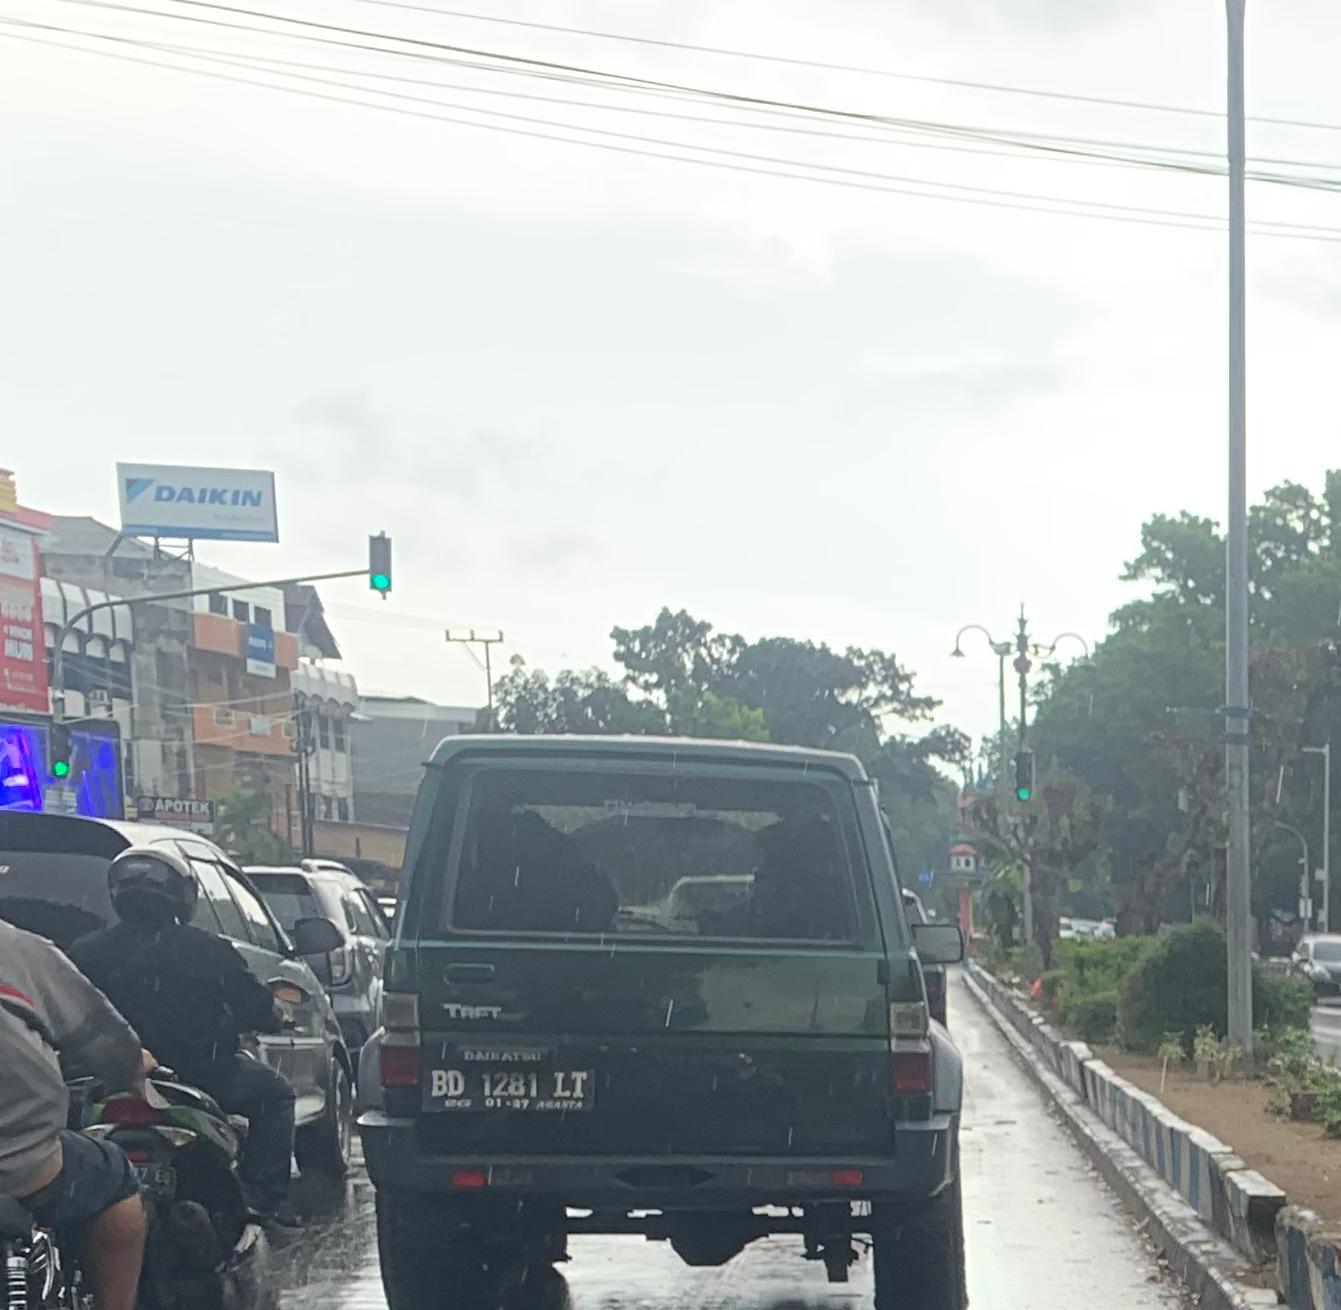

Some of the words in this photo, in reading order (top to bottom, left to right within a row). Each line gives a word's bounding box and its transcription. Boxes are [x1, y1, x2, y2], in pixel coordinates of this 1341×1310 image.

[154, 485, 263, 507] DAIKIN
[155, 799, 209, 815] APOTEK
[431, 1069, 465, 1097] BD
[481, 1071, 537, 1098] 1281
[553, 1071, 587, 1099] LT
